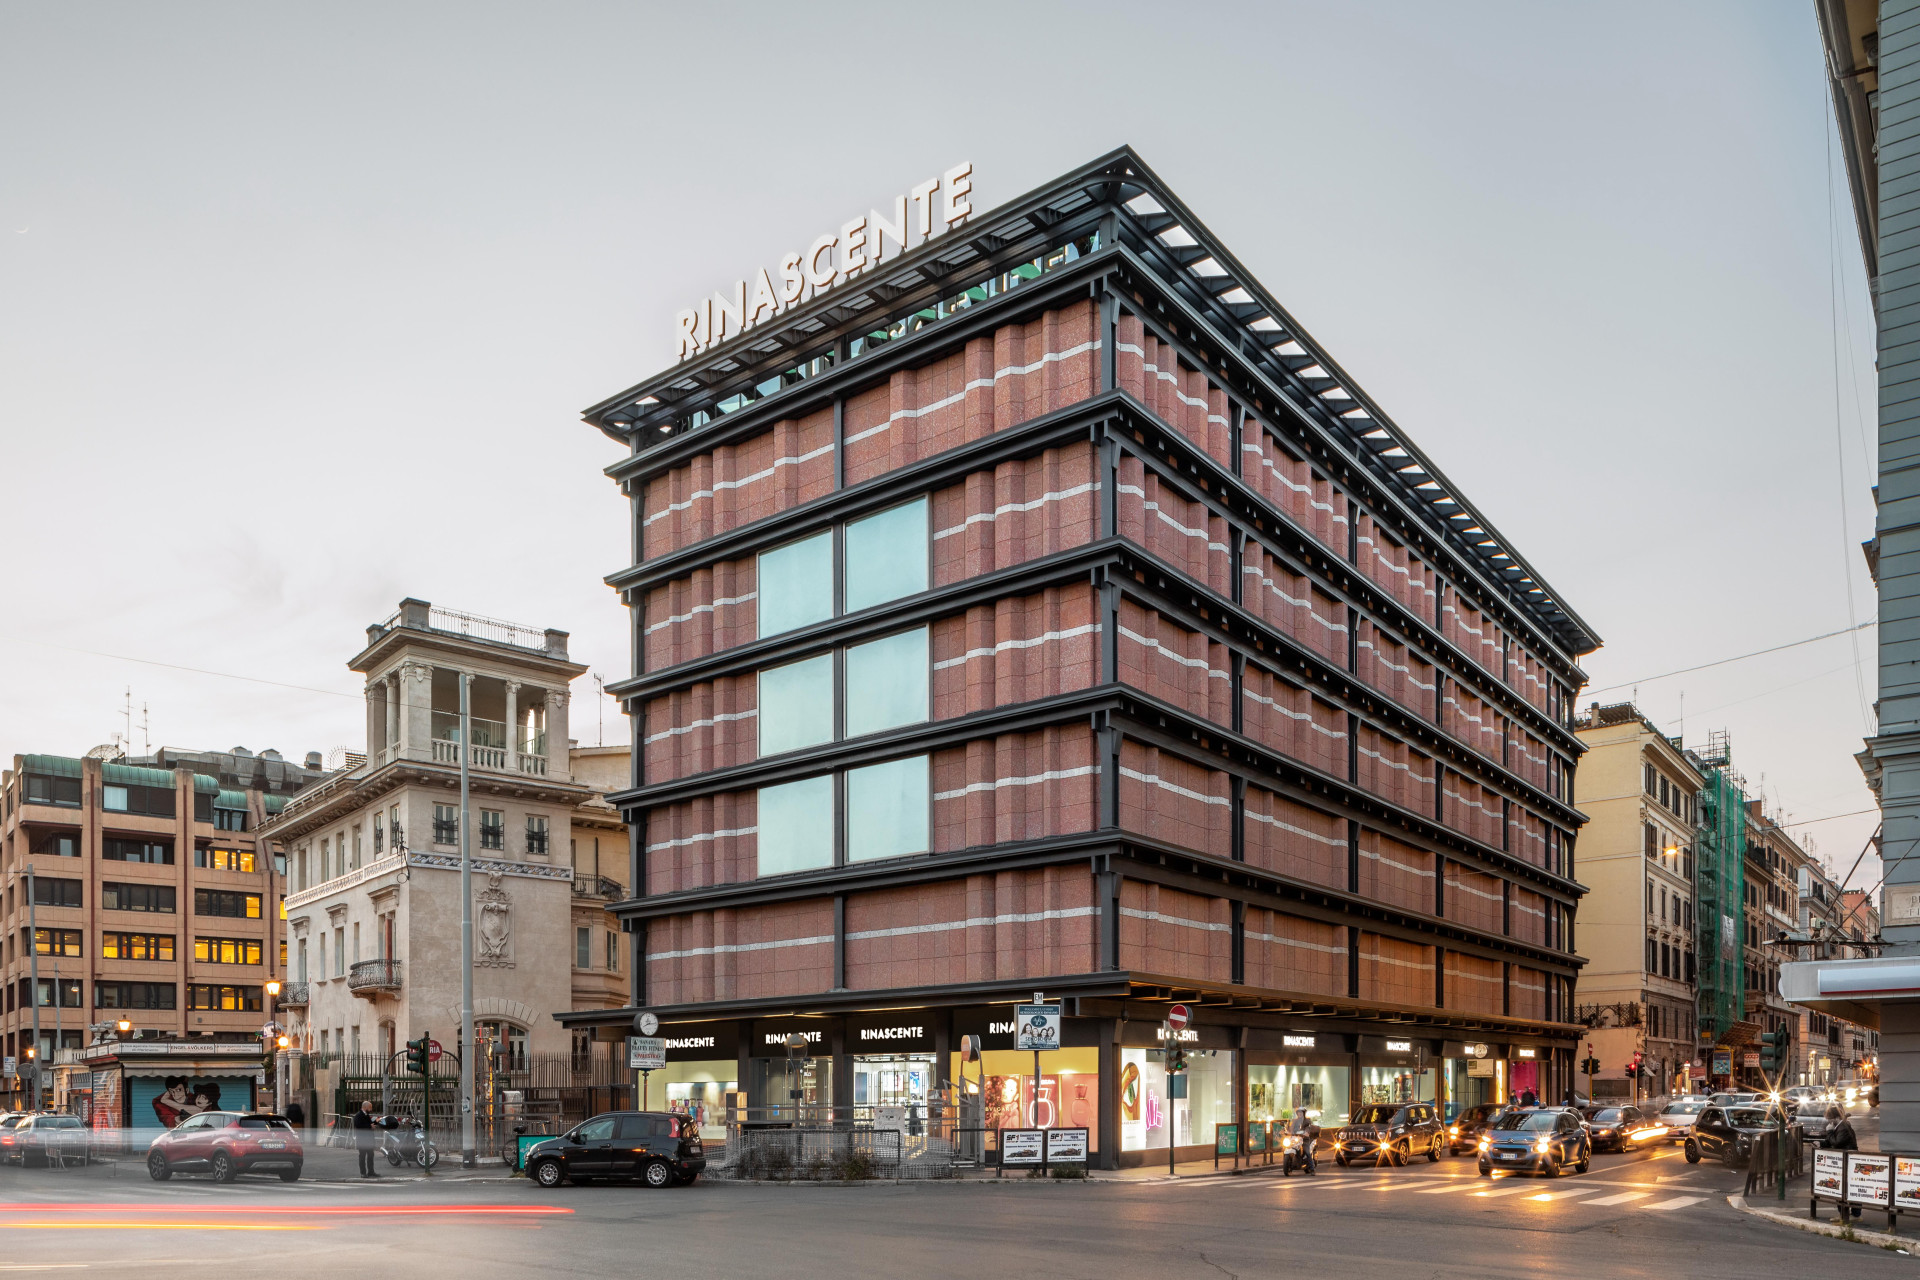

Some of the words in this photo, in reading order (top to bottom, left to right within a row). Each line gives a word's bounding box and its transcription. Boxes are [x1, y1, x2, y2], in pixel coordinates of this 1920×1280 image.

[676, 161, 973, 357] RINASCENTE
[1034, 993, 1043, 1001] EM
[860, 1026, 923, 1040] RINASCENTE
[665, 1036, 715, 1048] RINASCENTE
